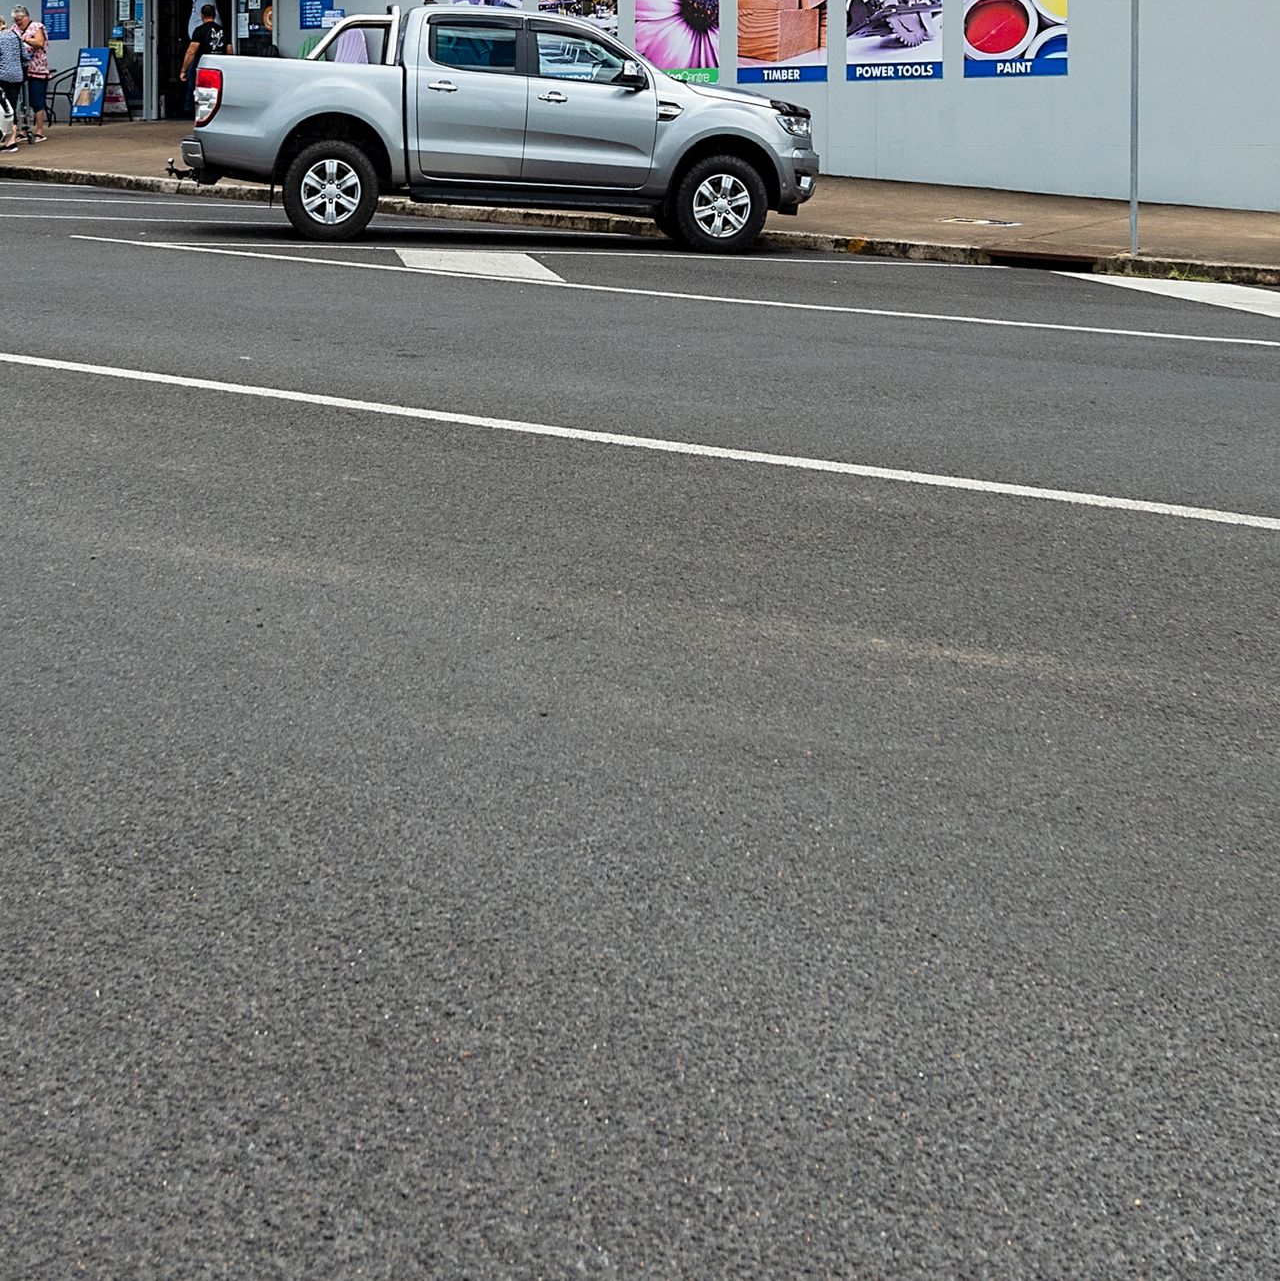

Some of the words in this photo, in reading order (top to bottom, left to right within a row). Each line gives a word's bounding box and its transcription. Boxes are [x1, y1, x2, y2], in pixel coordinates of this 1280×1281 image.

[855, 66, 895, 78] POWER
[897, 64, 934, 77] TOOLS
[996, 62, 1033, 74] PAINT
[762, 69, 801, 81] TIMBER
